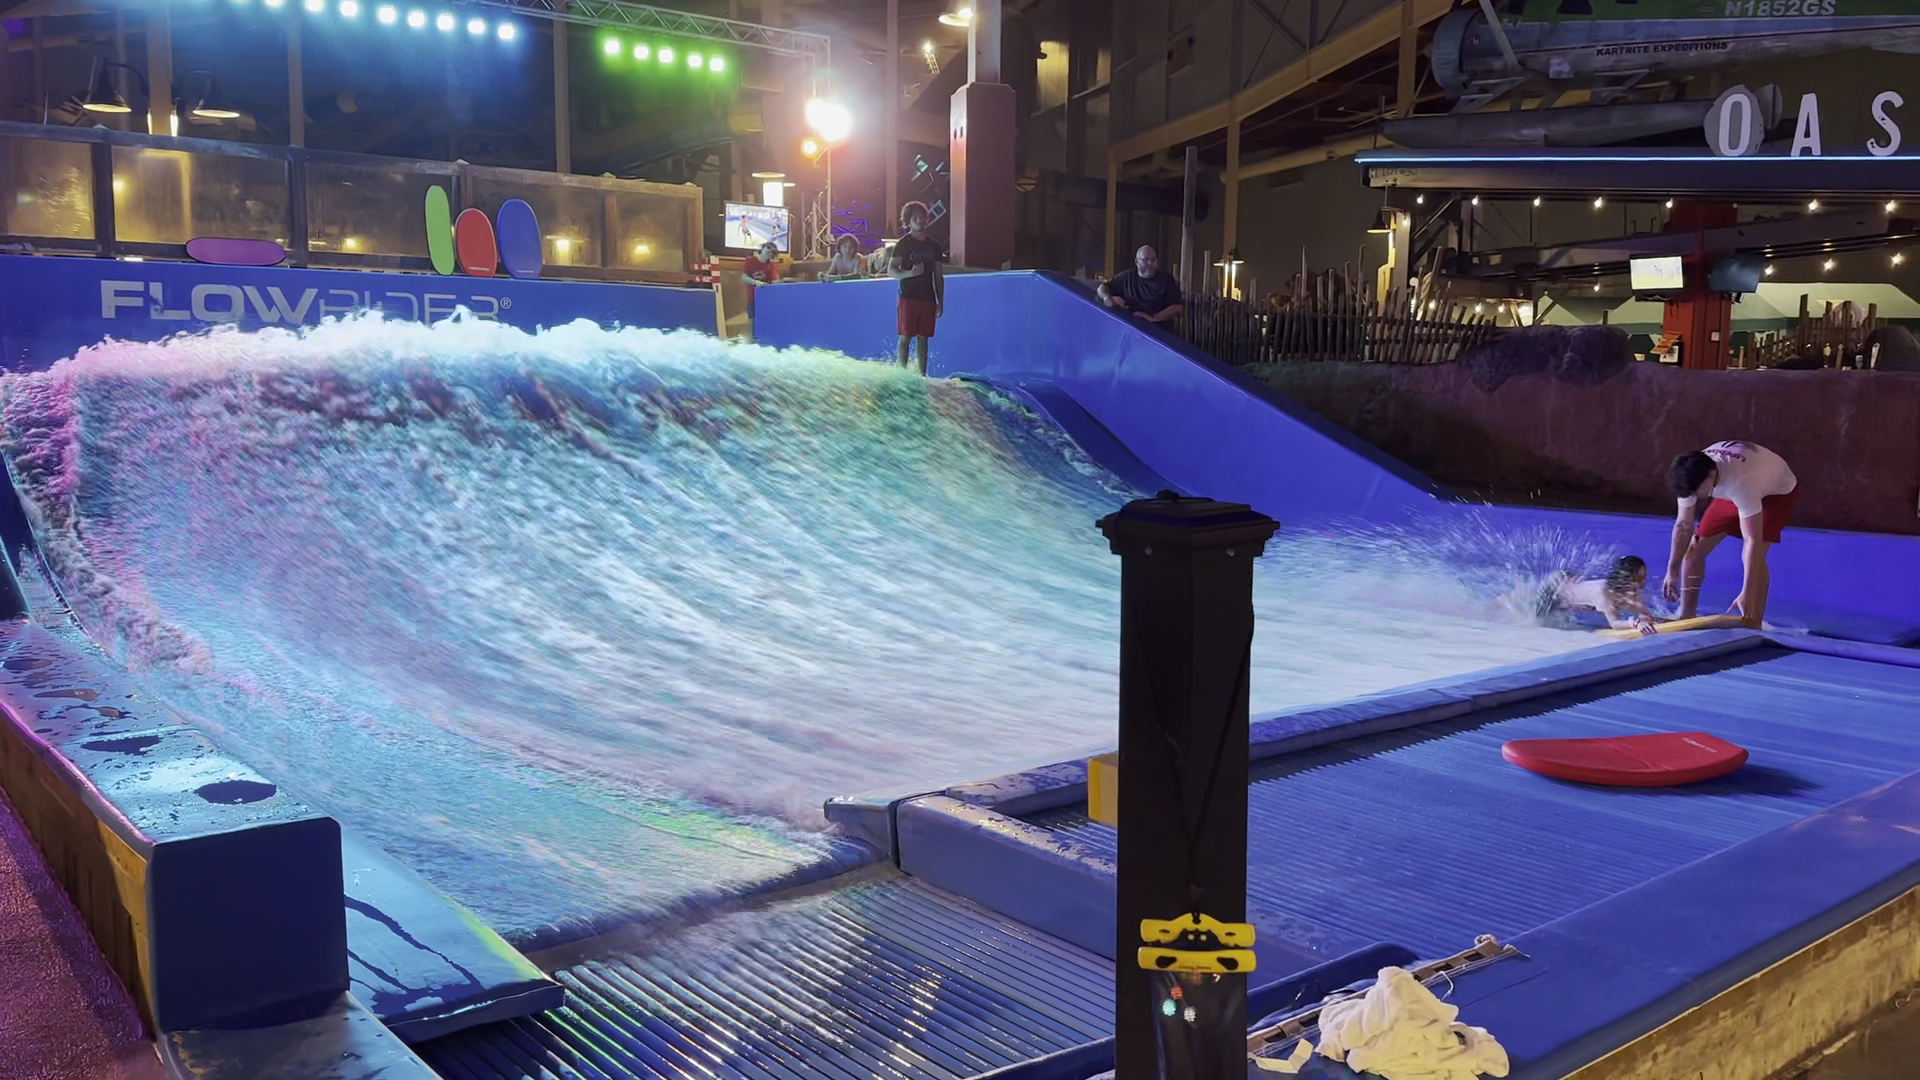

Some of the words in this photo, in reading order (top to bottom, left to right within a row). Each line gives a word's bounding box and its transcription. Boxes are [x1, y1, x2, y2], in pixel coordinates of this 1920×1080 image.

[1725, 0, 1836, 16] N1852GS
[1596, 45, 1649, 56] KARTRITE
[1653, 41, 1728, 52] EXPEDITIONS
